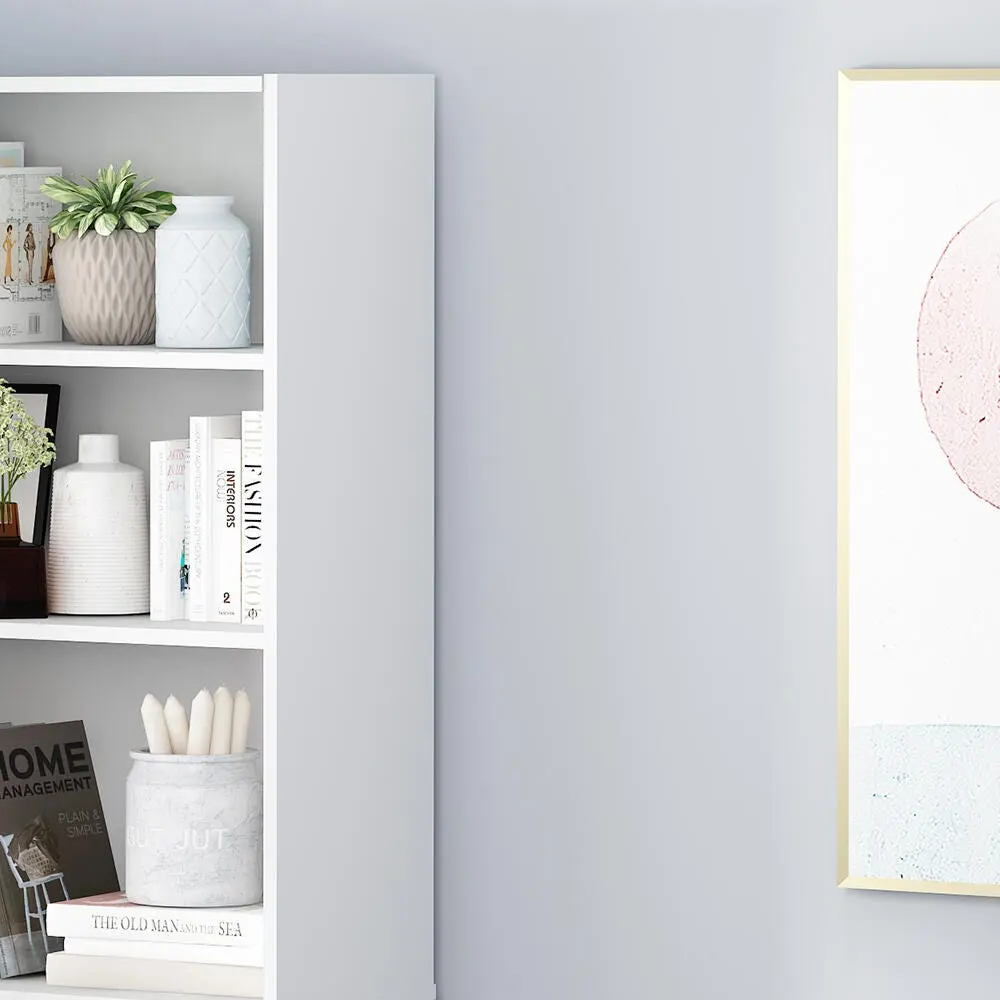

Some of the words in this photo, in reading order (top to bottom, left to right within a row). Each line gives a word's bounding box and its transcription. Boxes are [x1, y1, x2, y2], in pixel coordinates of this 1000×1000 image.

[226, 470, 236, 529] INTERIORS
[223, 592, 231, 604] 2
[57, 810, 89, 824] PLAIN
[65, 823, 103, 838] SIMPLE
[91, 914, 119, 930] THE
[120, 915, 148, 932] OLD
[151, 918, 179, 933] MAN
[218, 921, 243, 937] SEA
